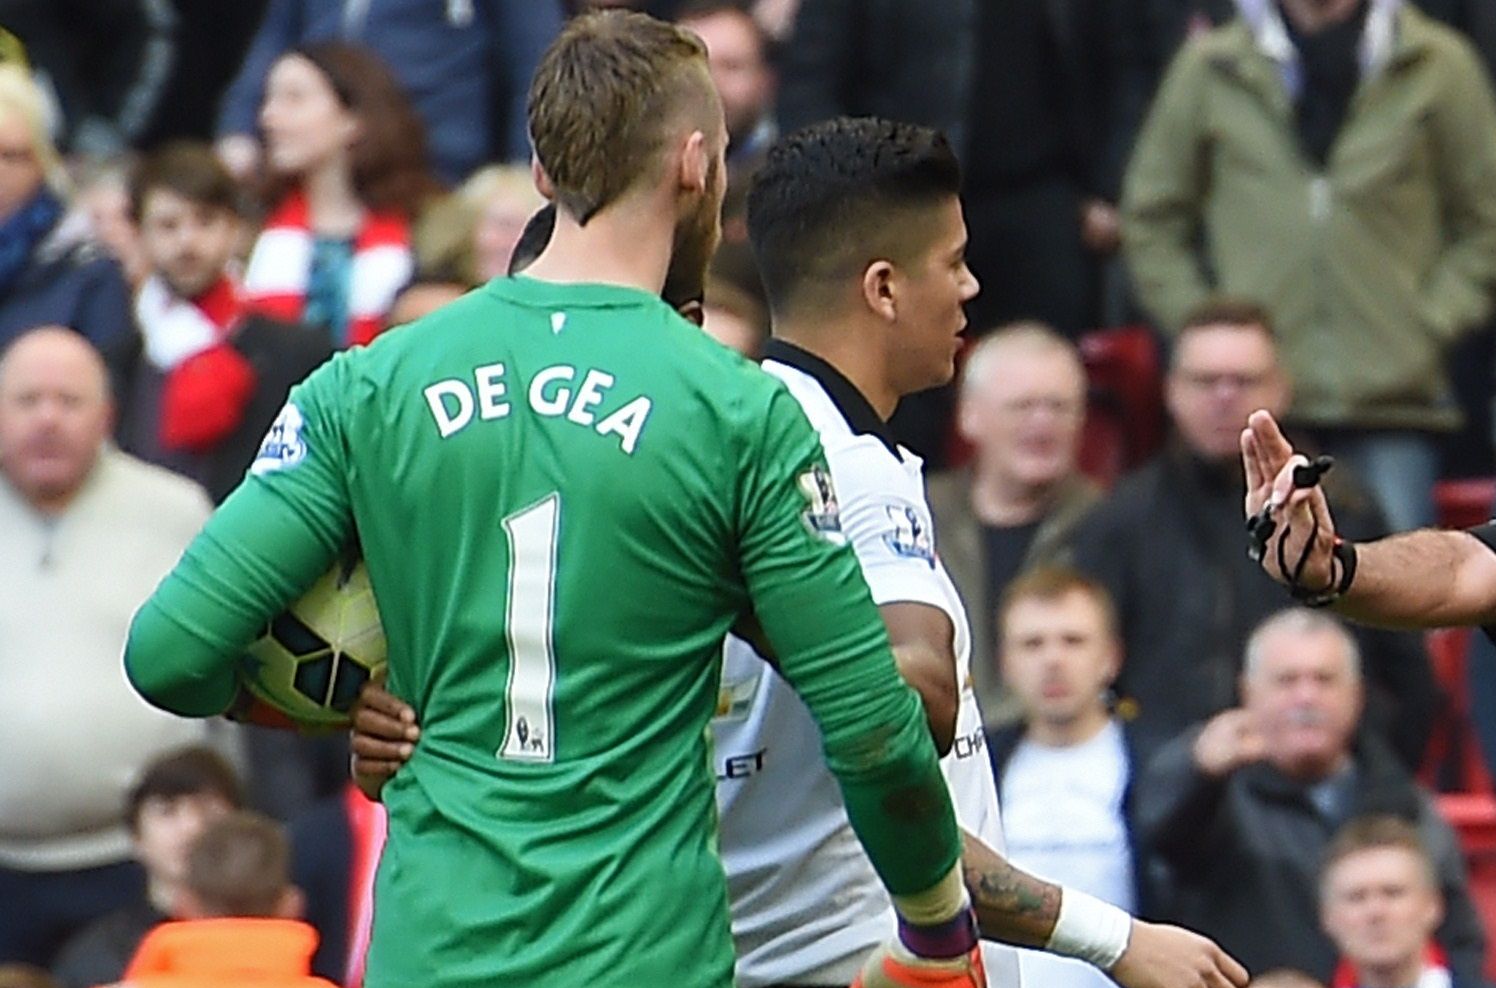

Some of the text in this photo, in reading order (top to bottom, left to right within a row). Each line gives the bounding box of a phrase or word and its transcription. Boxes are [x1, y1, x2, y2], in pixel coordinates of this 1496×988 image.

[423, 361, 653, 455] DE GEA
[497, 491, 560, 761] 1
